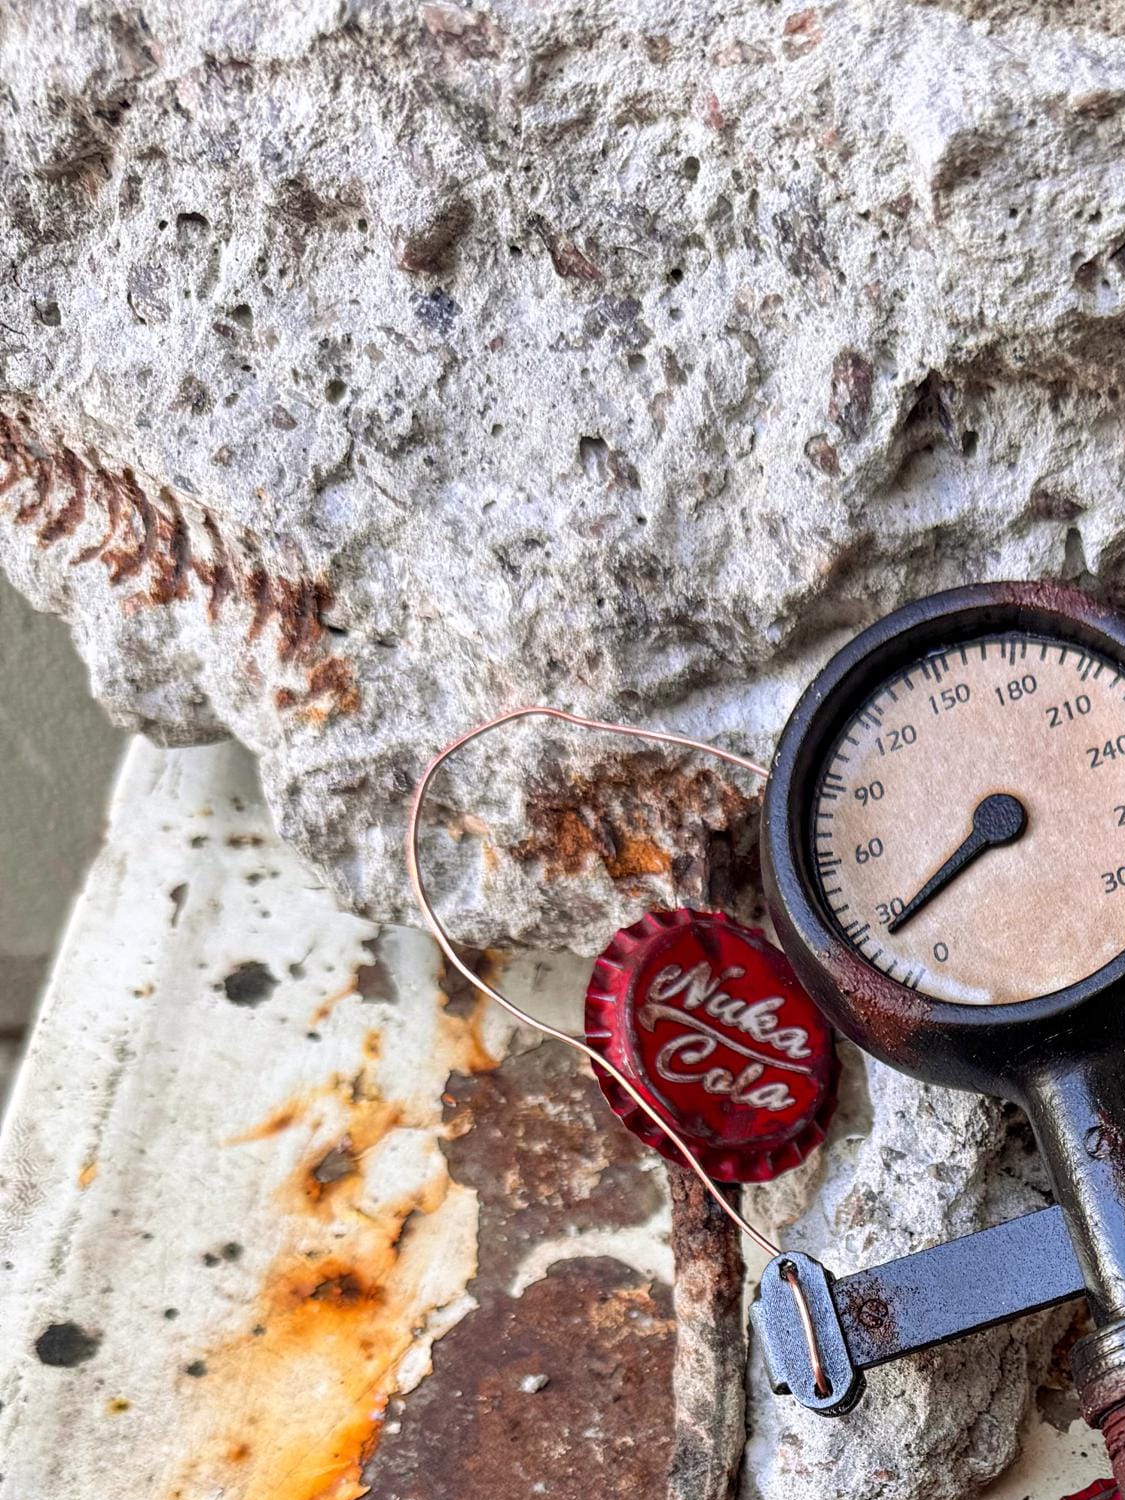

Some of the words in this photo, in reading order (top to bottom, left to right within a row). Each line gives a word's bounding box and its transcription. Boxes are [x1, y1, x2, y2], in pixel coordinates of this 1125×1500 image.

[928, 683, 971, 715] 150
[993, 674, 1038, 707] 180
[1045, 693, 1092, 729] 210
[874, 724, 917, 757] 120
[854, 780, 885, 808] 90
[855, 837, 884, 865] 60
[875, 896, 905, 926] 30
[932, 941, 949, 964] 0
[648, 961, 811, 1060] Nuka
[655, 1033, 796, 1111] Cola
